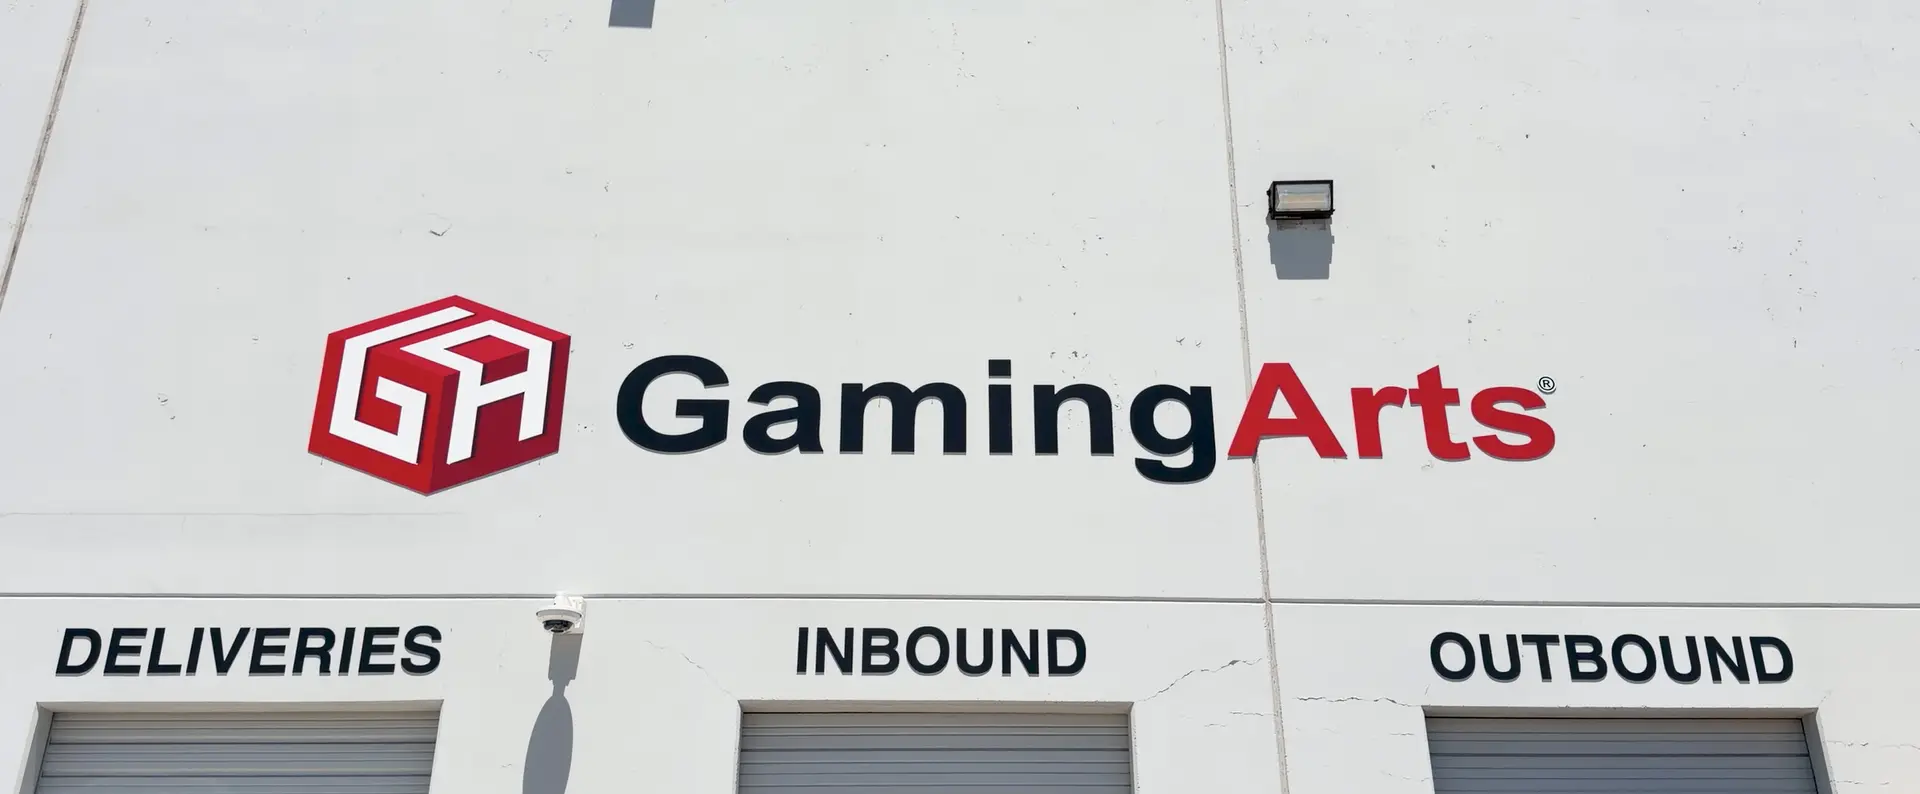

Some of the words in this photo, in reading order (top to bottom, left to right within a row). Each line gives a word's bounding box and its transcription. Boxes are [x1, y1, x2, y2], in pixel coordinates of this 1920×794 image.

[56, 626, 442, 676] DELIVERIES
[796, 626, 1087, 676] INBOUND
[1430, 631, 1794, 684] OUTBOUND
